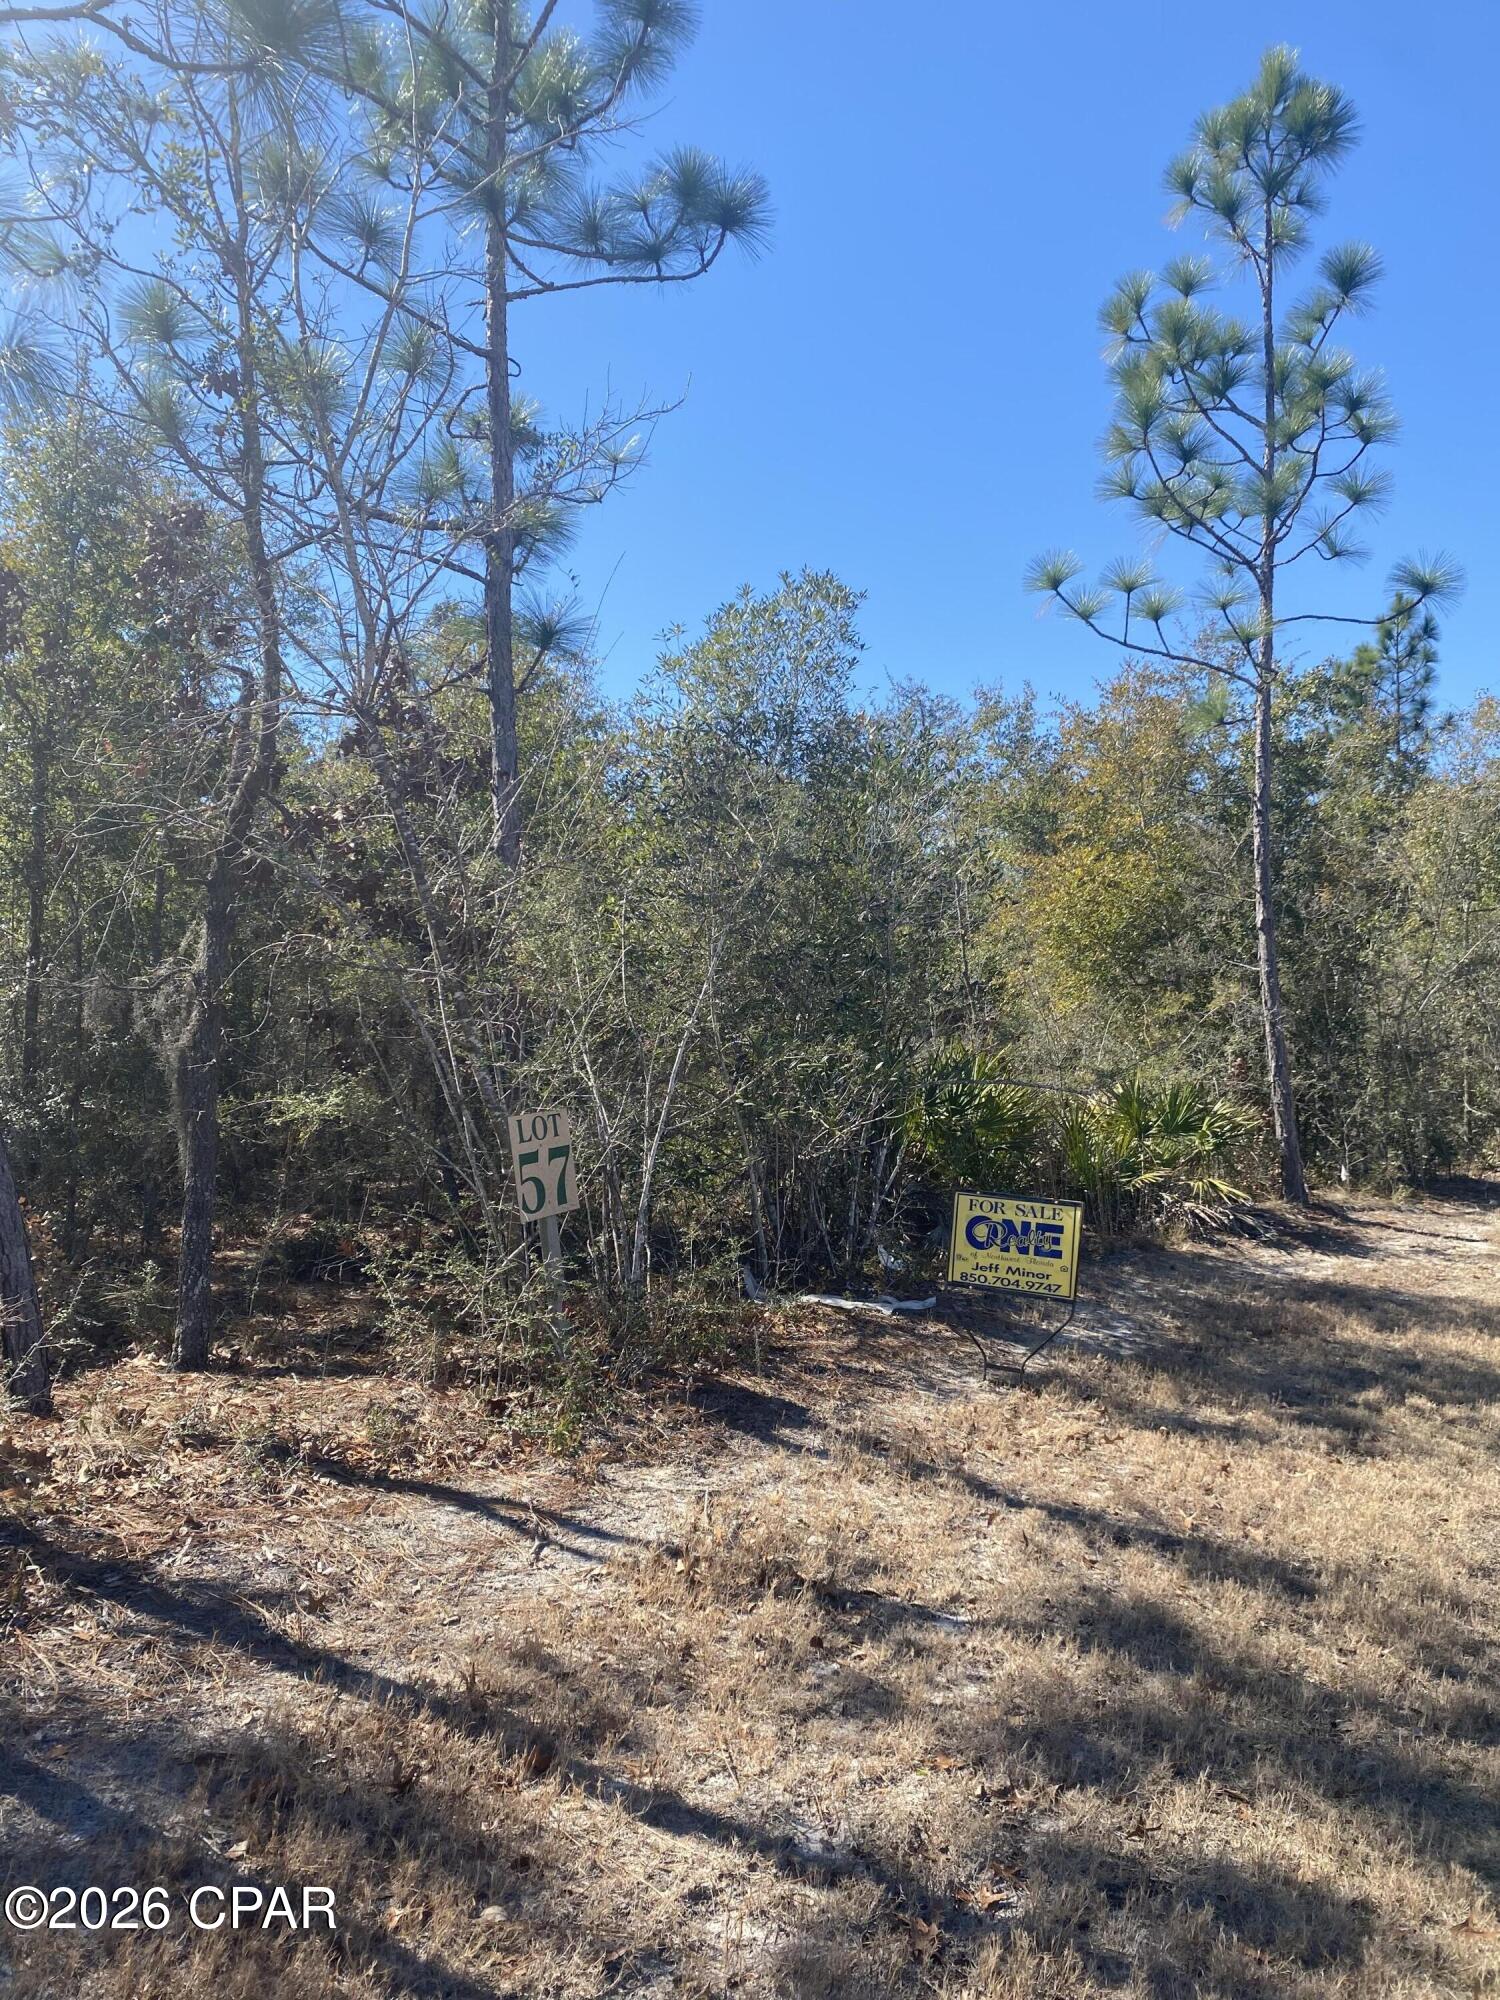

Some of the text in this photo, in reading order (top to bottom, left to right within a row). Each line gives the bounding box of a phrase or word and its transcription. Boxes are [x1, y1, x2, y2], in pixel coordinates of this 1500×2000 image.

[516, 1113, 561, 1144] LOT
[518, 1145, 570, 1214] 57
[968, 1199, 1064, 1221] FOR SALE
[965, 1215, 1065, 1259] ONE
[972, 1219, 1053, 1251] Realty
[960, 1272, 1063, 1293] 850.704.9747
[971, 1261, 1053, 1280] Jeff Minor
